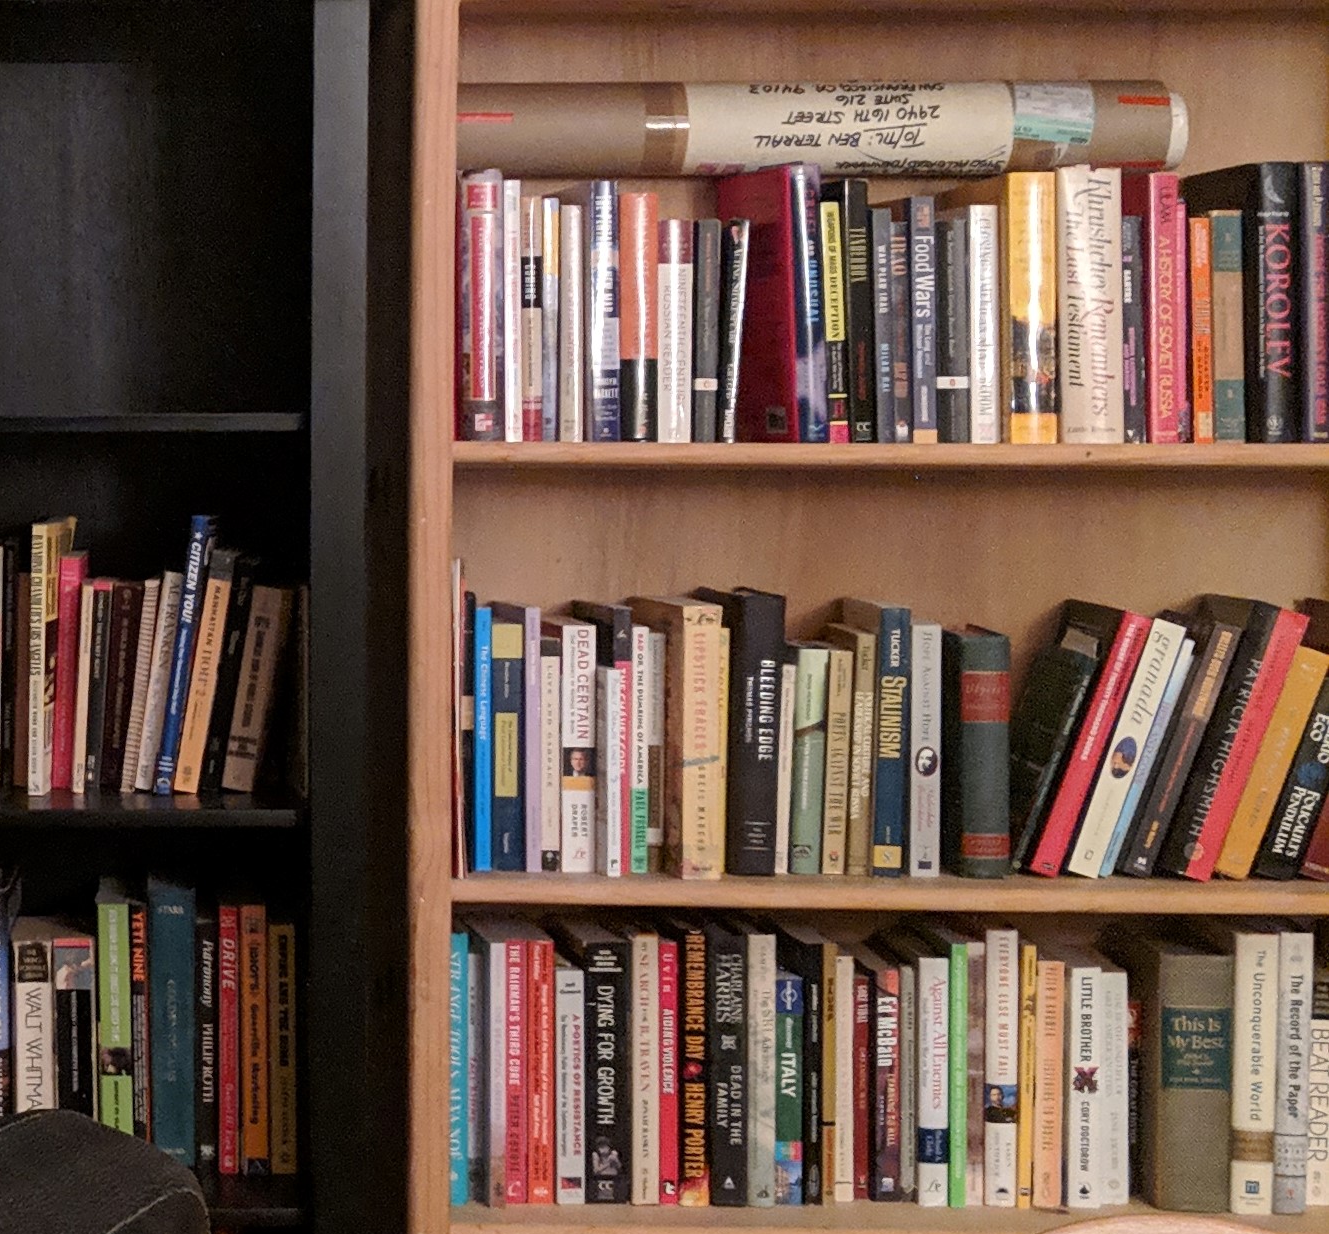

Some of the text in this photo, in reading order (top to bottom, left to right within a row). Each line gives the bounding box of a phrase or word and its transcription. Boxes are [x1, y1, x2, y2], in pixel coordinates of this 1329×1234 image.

[753, 134, 821, 147] TERRALL
[782, 105, 939, 124] 2940 16TH STREET
[829, 134, 860, 148] BEN
[836, 94, 911, 105] SUITE 216
[849, 227, 866, 283] TINDERBOX
[891, 236, 906, 275] IRAQ
[915, 235, 933, 317] Food Wars
[1066, 204, 1087, 387] The Last Testament
[1159, 237, 1172, 418] A HISTORY OF SOVIET RUSSIA
[1265, 223, 1291, 377] KOROLEV
[480, 663, 488, 698] Chinese
[577, 629, 589, 739] DEAD CERTAIN
[758, 660, 775, 761] BLEEDING EDGE
[879, 629, 907, 759] TUCKER STALINISM
[1130, 631, 1171, 725] granada
[479, 701, 488, 740] Language
[1188, 659, 1263, 836] PATRICIA HIGHSMITH
[571, 804, 579, 837] DRAPER
[580, 804, 588, 837] ROBERT
[222, 938, 234, 989] DRIVE
[509, 945, 521, 1085] THE RAINMAN'S THIRD CURE
[998, 936, 1010, 1077] EVERYONE ELSE MUST FAIL
[1079, 977, 1093, 1062] LITTLE BROTHER
[1286, 975, 1303, 1118] The Record of the Paper
[597, 986, 614, 1125] DYING FOR GROWTH
[1308, 1028, 1328, 1161] BEAT READER
[717, 1082, 728, 1127] FAMILY
[730, 1066, 742, 1145] DEAD IN THE
